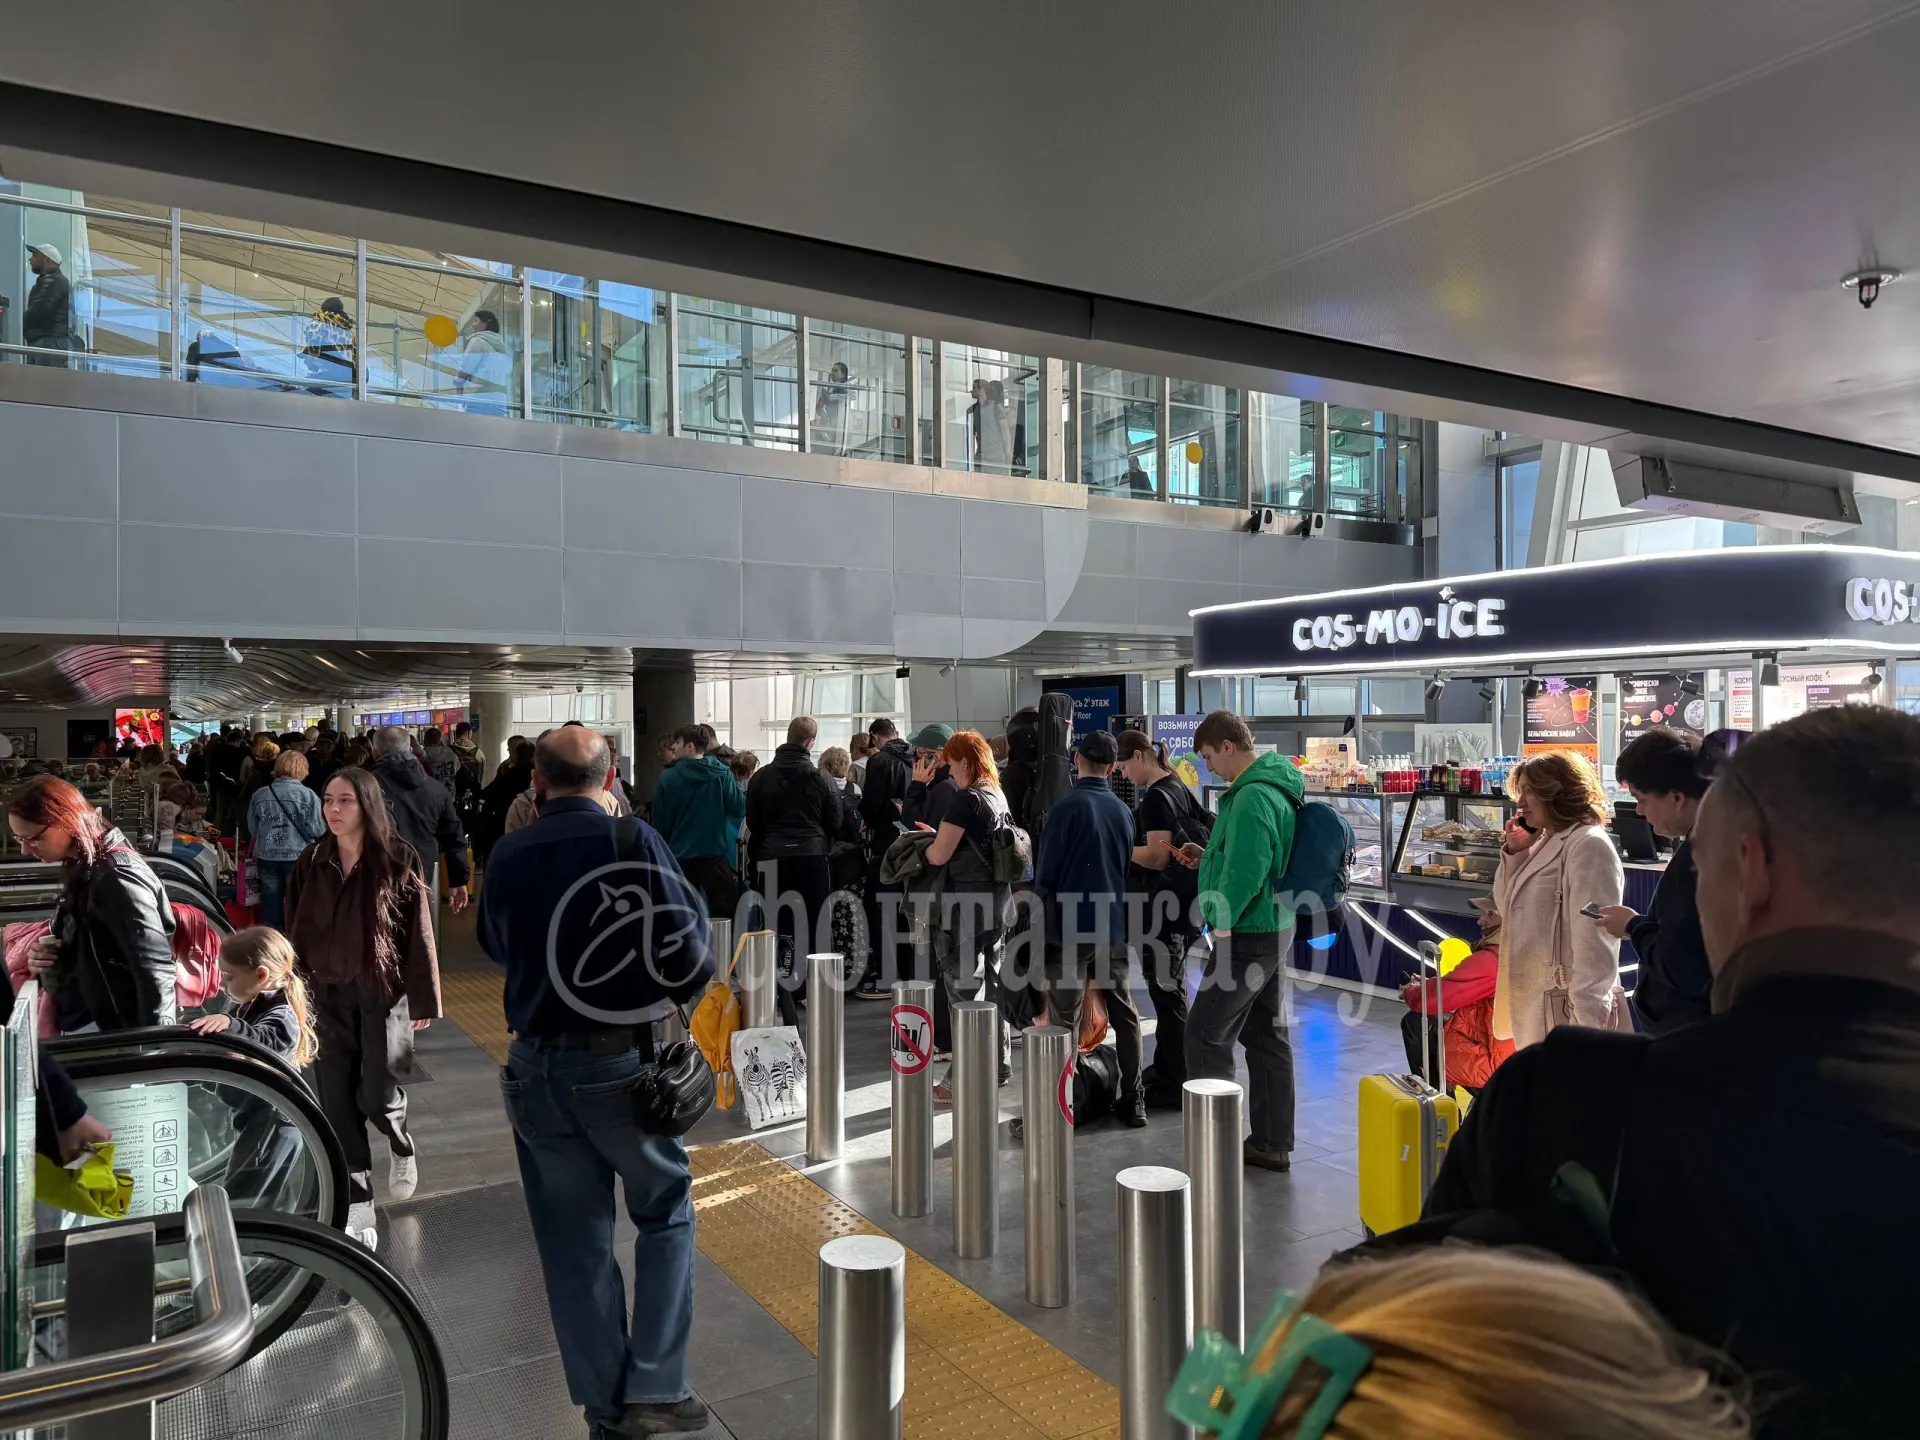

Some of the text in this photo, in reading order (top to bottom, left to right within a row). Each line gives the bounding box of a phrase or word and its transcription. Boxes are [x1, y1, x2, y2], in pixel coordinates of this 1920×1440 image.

[1292, 598, 1506, 651] COS-MO-ICE
[1805, 674, 1823, 682] КОФЕ
[1091, 699, 1110, 708] этаж
[1077, 711, 1092, 720] floor
[1158, 721, 1188, 730] ВОЗЬМИ
[1169, 736, 1194, 748] СОБО
